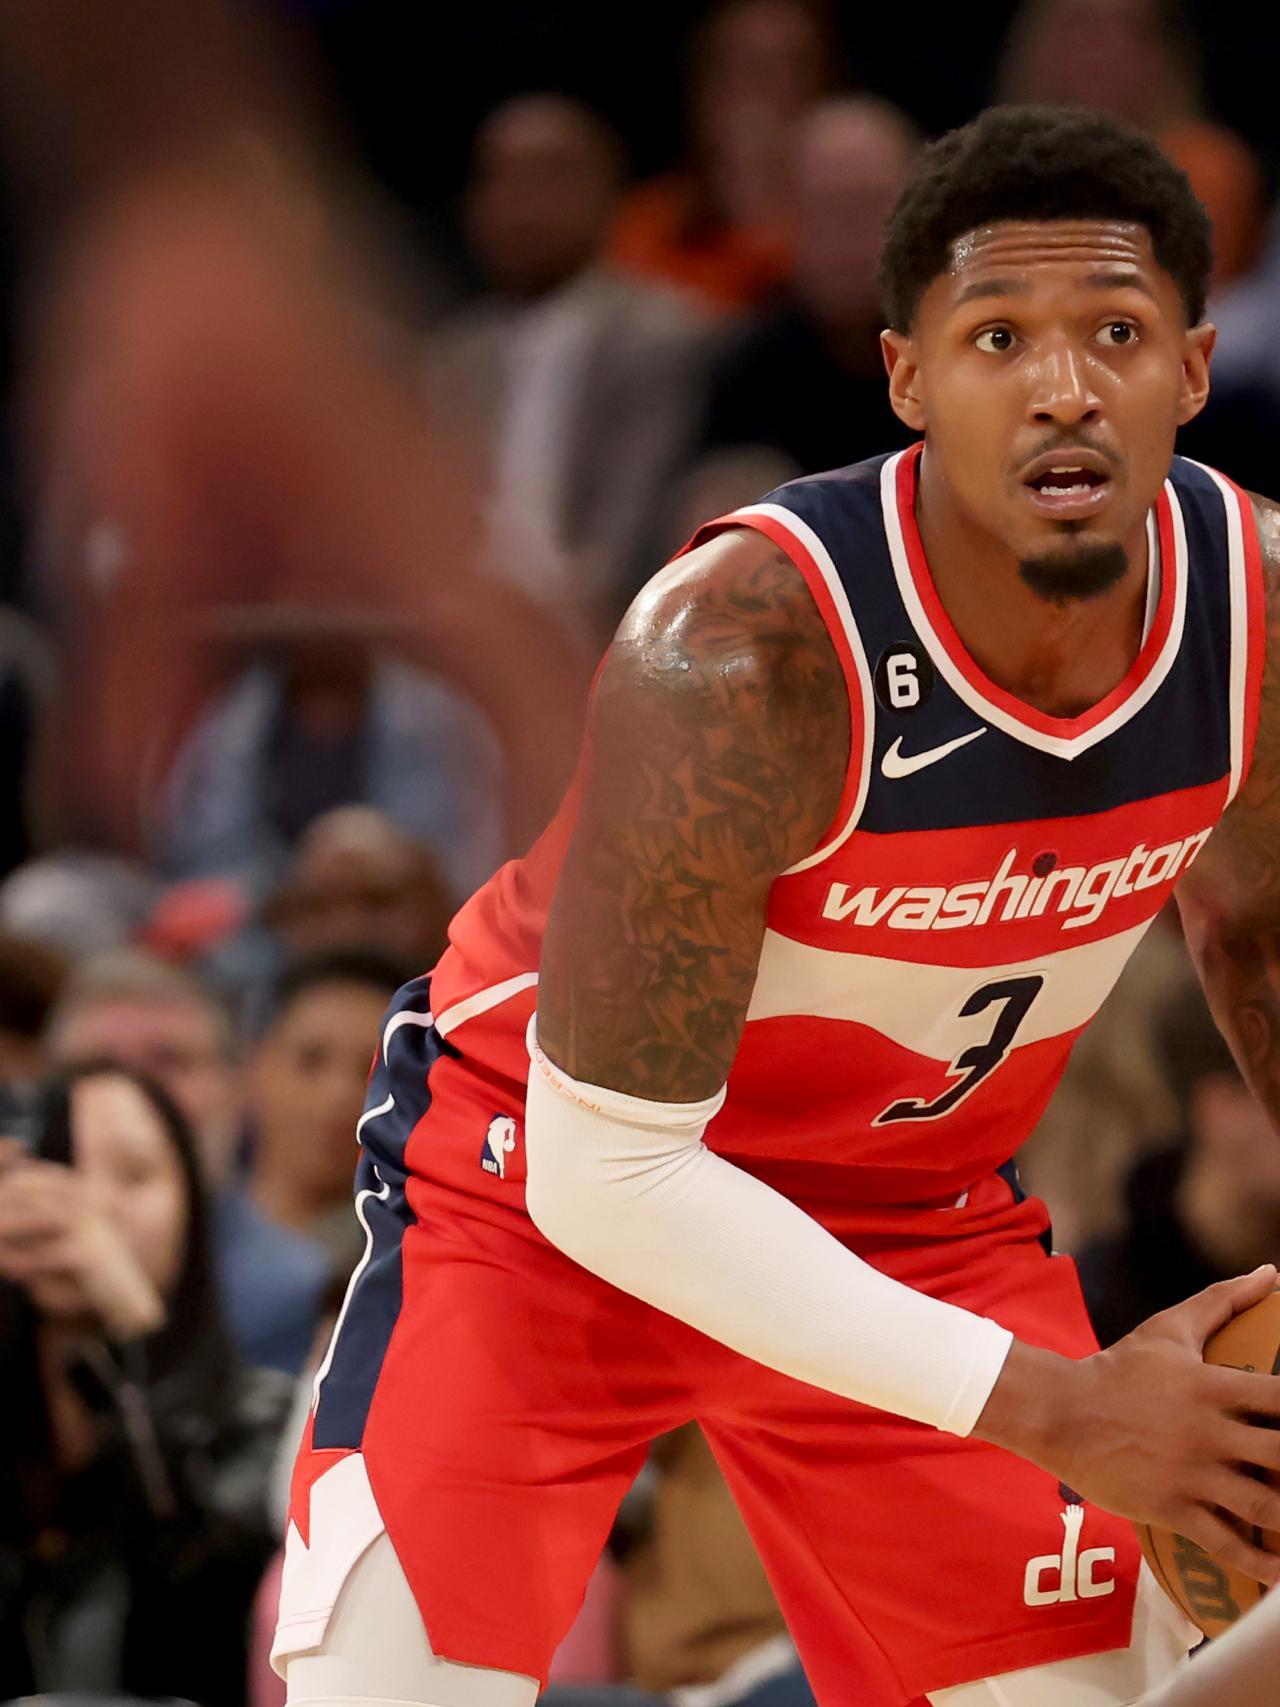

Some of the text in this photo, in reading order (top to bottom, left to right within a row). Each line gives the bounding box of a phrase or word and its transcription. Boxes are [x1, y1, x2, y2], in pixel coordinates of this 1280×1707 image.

[886, 653, 920, 708] 6
[821, 827, 1213, 930] washington
[870, 972, 1047, 1127] 3
[482, 1158, 498, 1174] NBA
